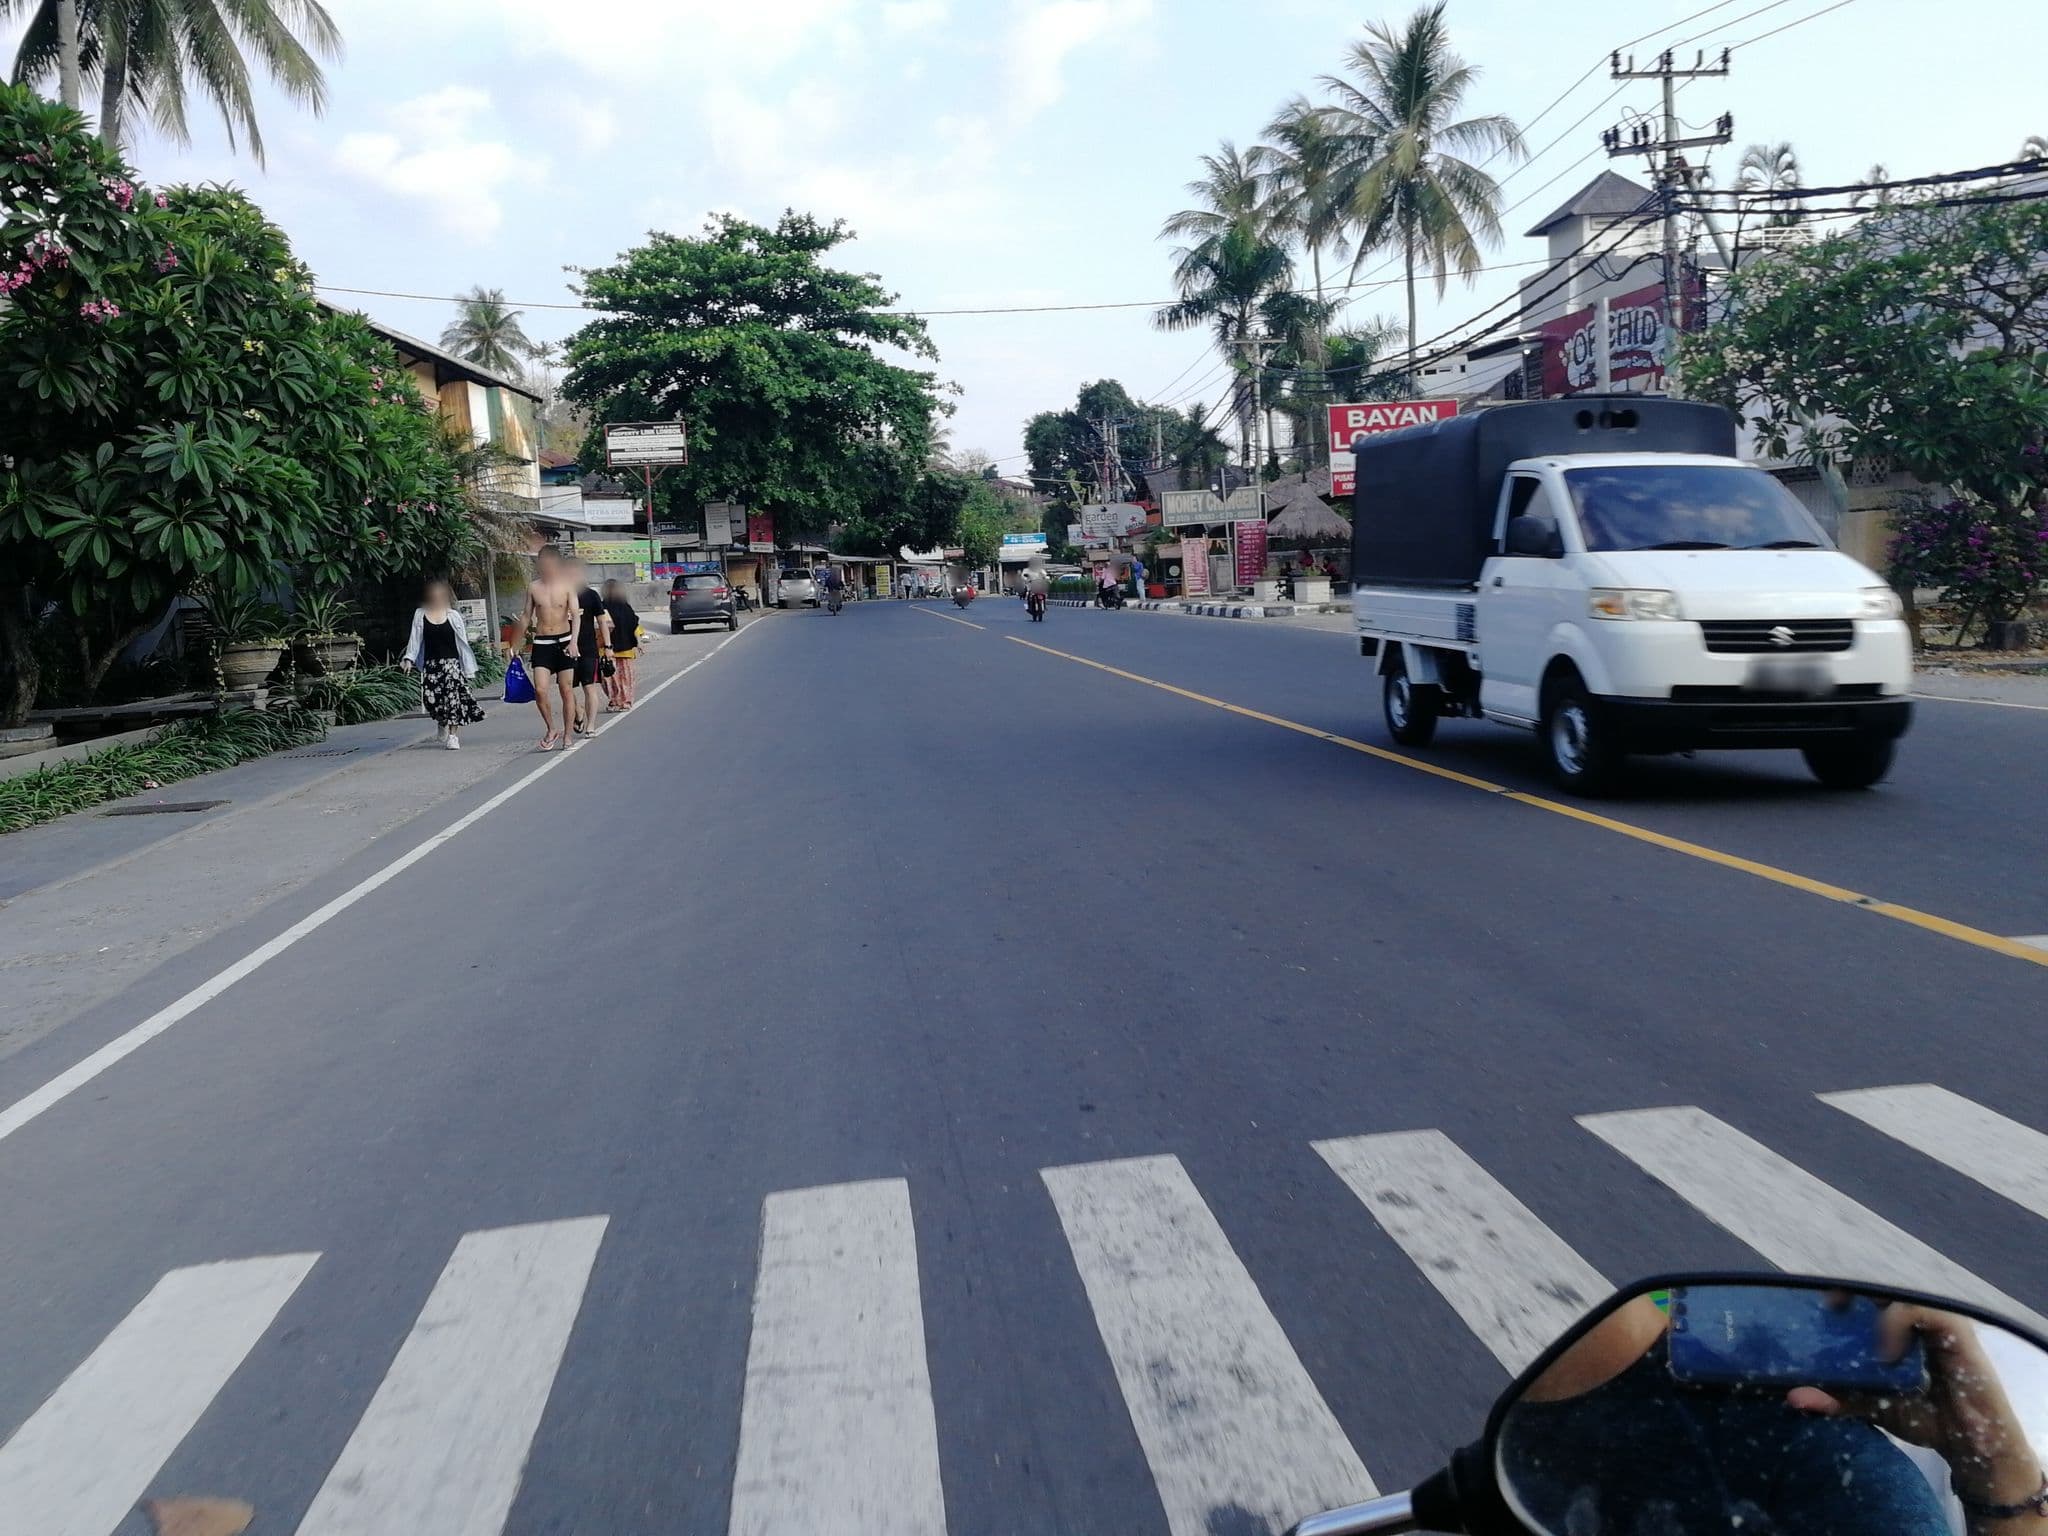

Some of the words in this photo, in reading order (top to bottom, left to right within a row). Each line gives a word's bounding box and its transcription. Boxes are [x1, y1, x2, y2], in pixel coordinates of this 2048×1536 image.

[1347, 406, 1437, 428] BAYAN
[1166, 493, 1204, 514] MONEY
[1206, 490, 1257, 511] CHANGER
[1085, 512, 1119, 523] garden
